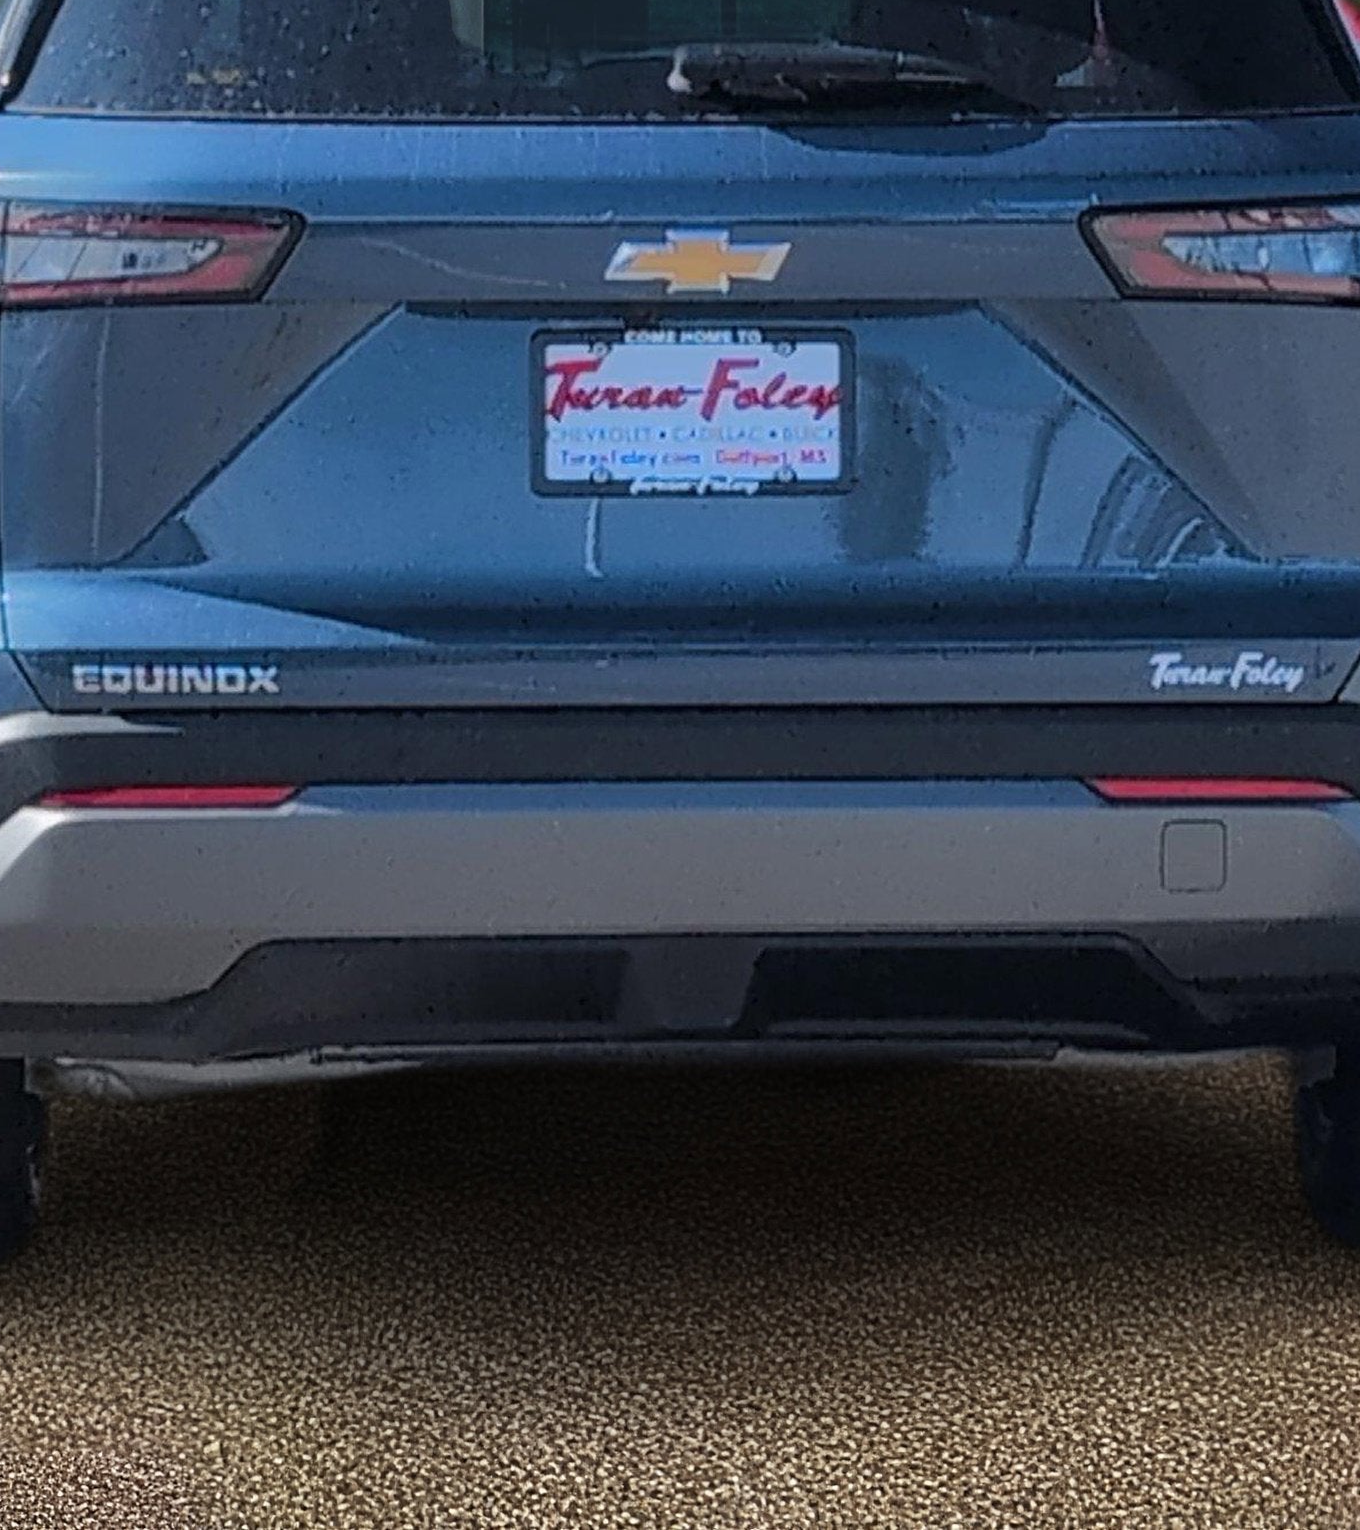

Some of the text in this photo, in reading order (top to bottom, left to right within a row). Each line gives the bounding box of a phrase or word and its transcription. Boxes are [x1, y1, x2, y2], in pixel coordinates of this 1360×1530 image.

[700, 357, 842, 421] Foley
[72, 664, 281, 695] EQUINOX
[1229, 650, 1305, 694] Foley
